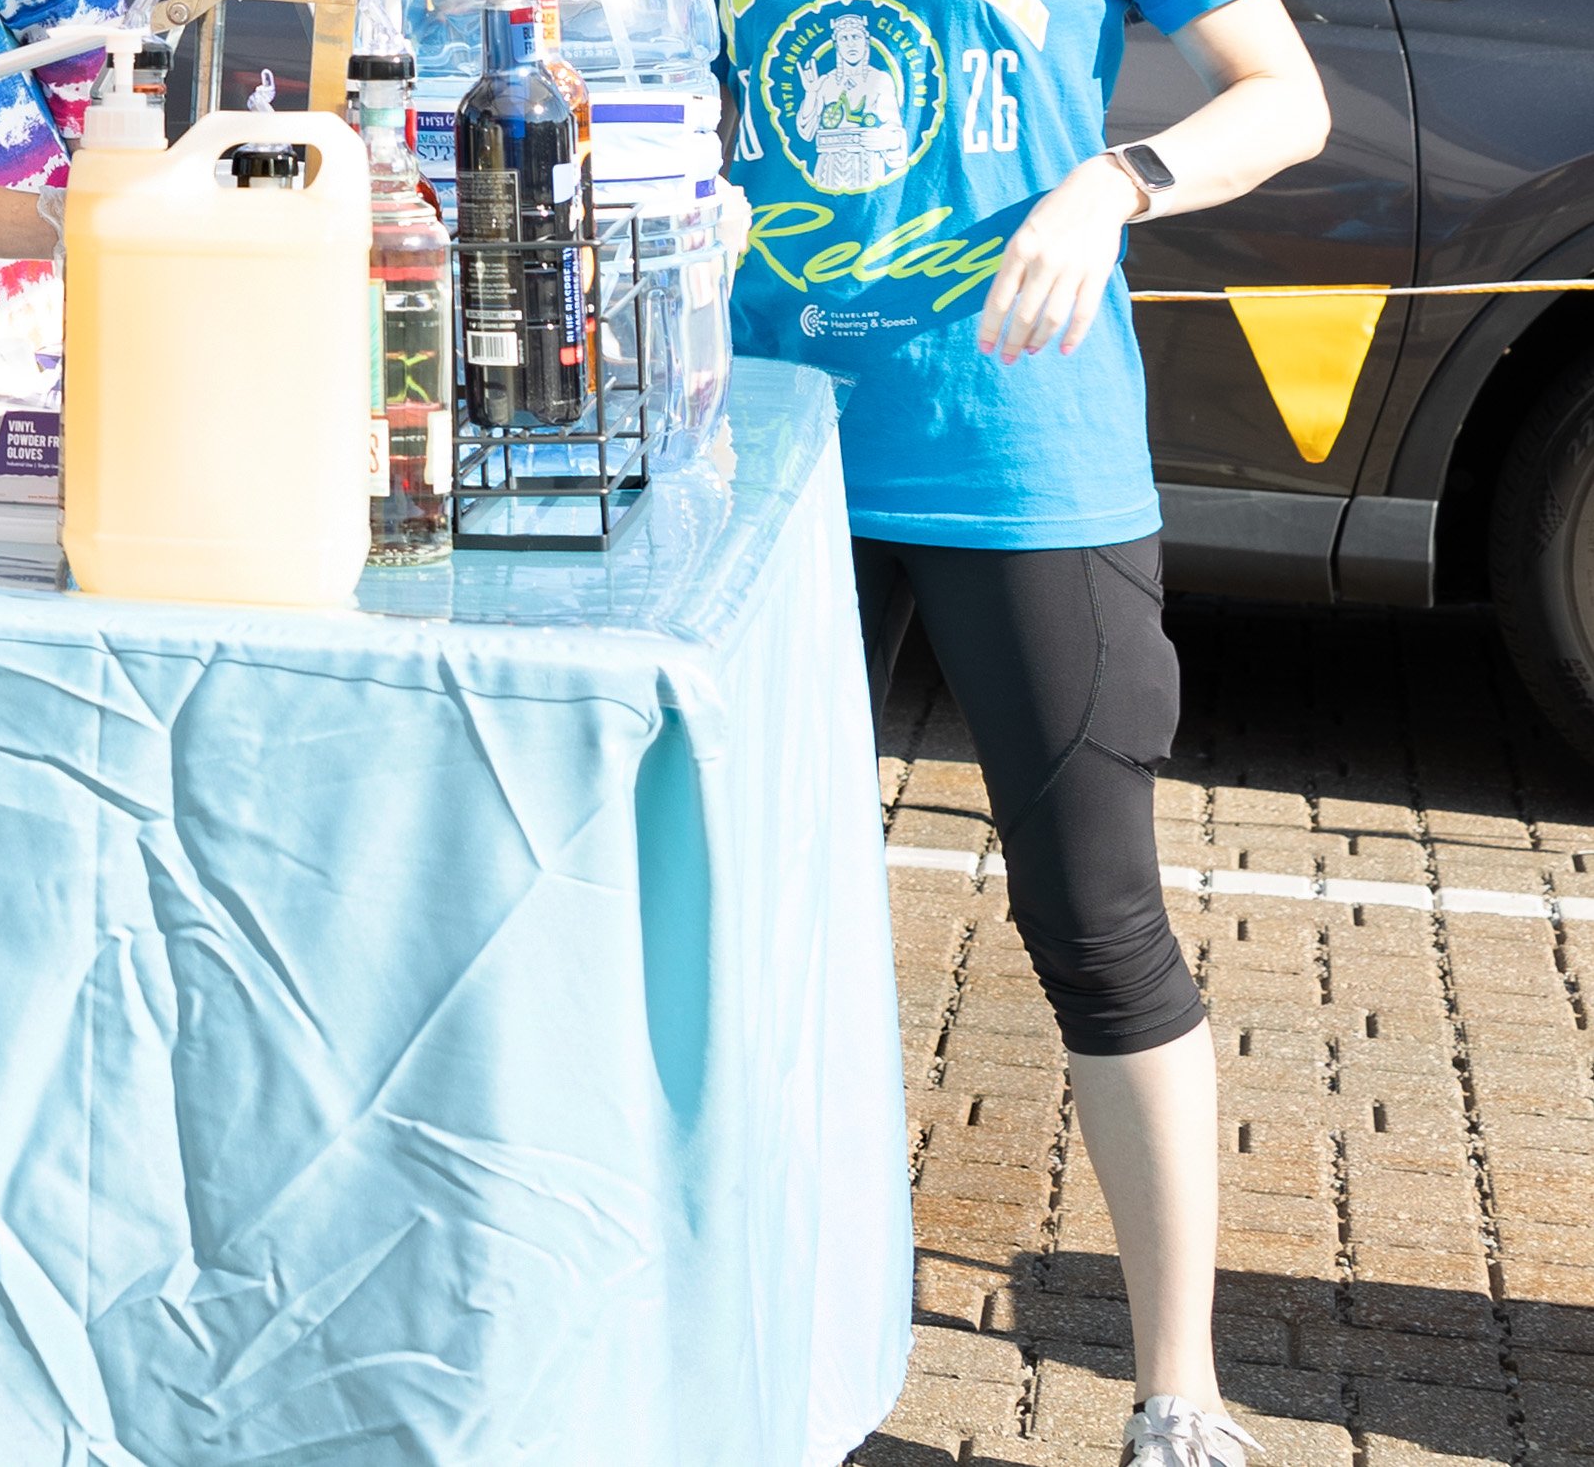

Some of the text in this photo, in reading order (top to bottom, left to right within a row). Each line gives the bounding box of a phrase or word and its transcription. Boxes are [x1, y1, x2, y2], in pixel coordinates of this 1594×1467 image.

[878, 17, 927, 107] CLEVELAND
[781, 23, 824, 118] 14TH ANNUAL
[962, 48, 1019, 154] 26
[736, 201, 1006, 313] Relay
[831, 311, 880, 319] CLEVELAND
[831, 315, 918, 331] Hearing & Speech
[8, 420, 36, 433] VINYL
[7, 433, 46, 447] POWDER
[6, 448, 43, 461] GLOVES
